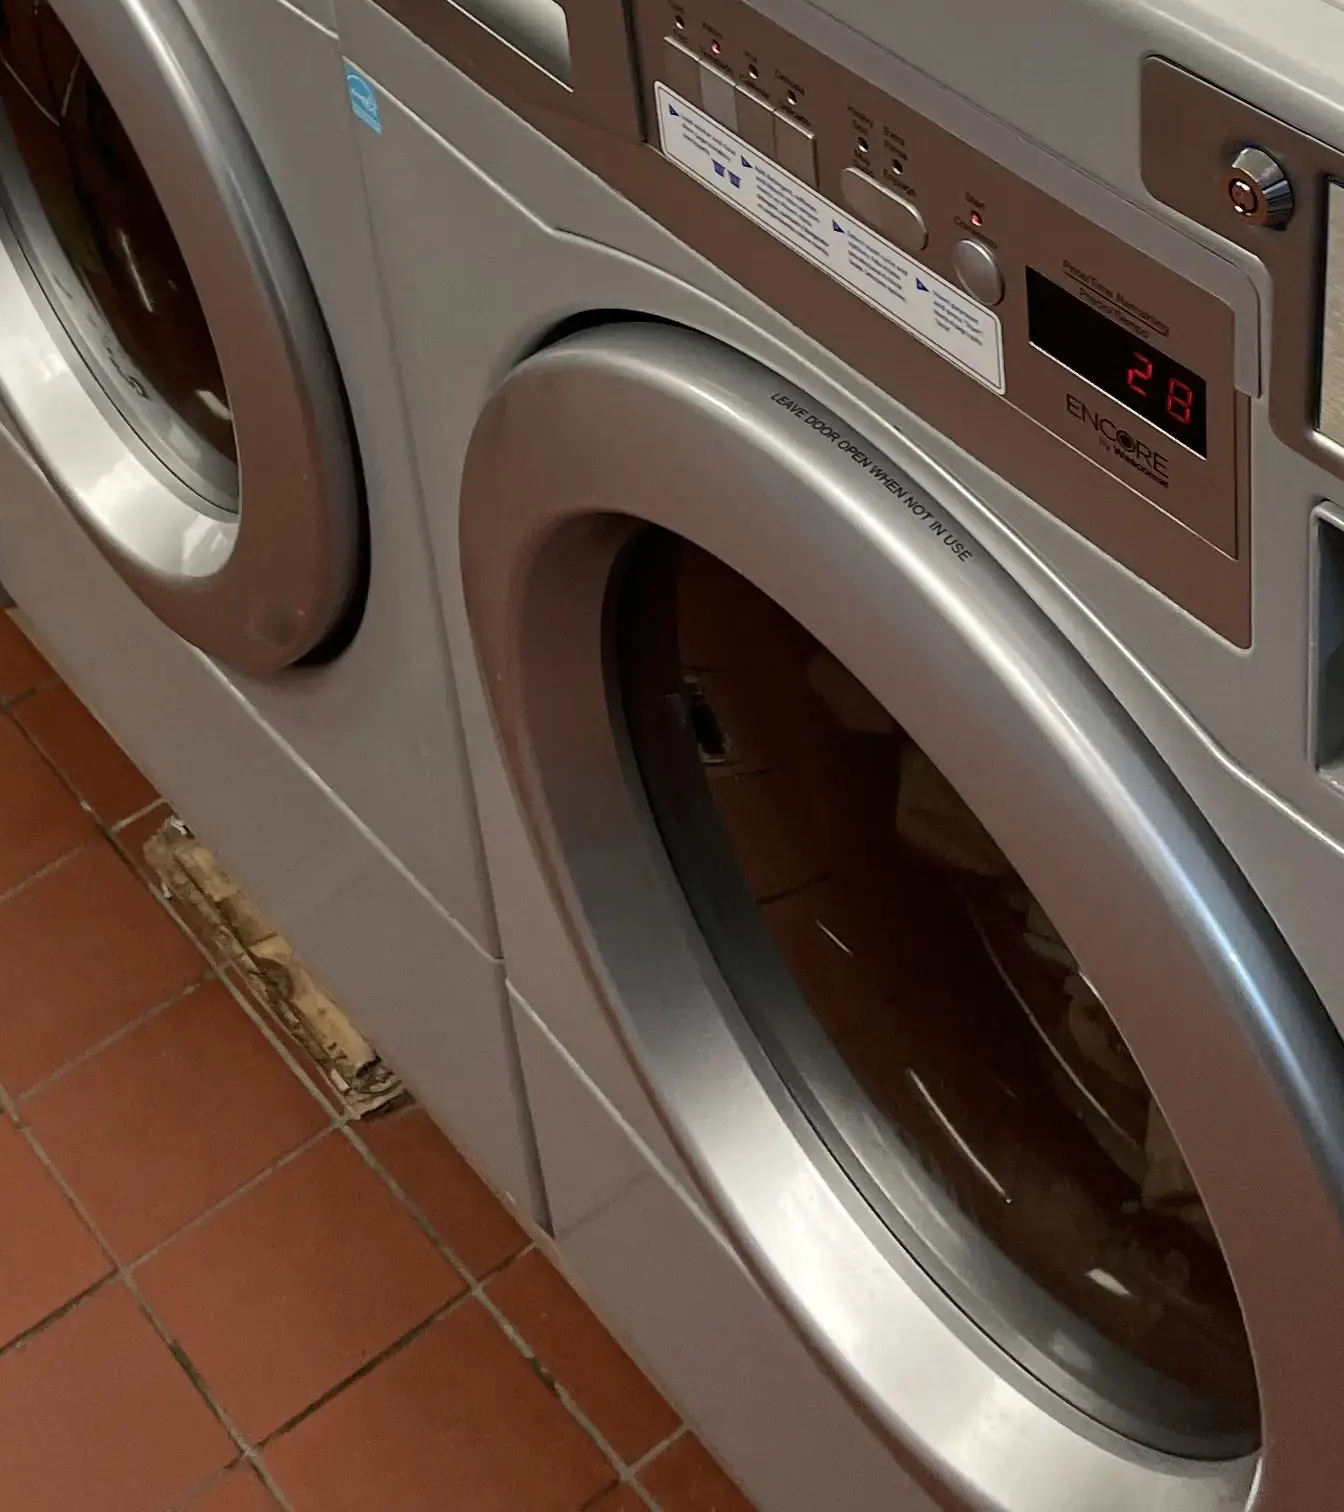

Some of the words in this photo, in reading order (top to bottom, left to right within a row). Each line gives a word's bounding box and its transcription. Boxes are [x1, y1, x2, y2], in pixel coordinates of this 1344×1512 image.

[770, 392, 808, 418] LEAVE
[804, 414, 840, 442] DOOR
[838, 440, 873, 467] OPEN
[869, 464, 907, 498] WHEN
[903, 498, 933, 521] NOT
[929, 520, 947, 536] IN
[943, 534, 973, 562] USE
[1066, 393, 1169, 478] ENCORE
